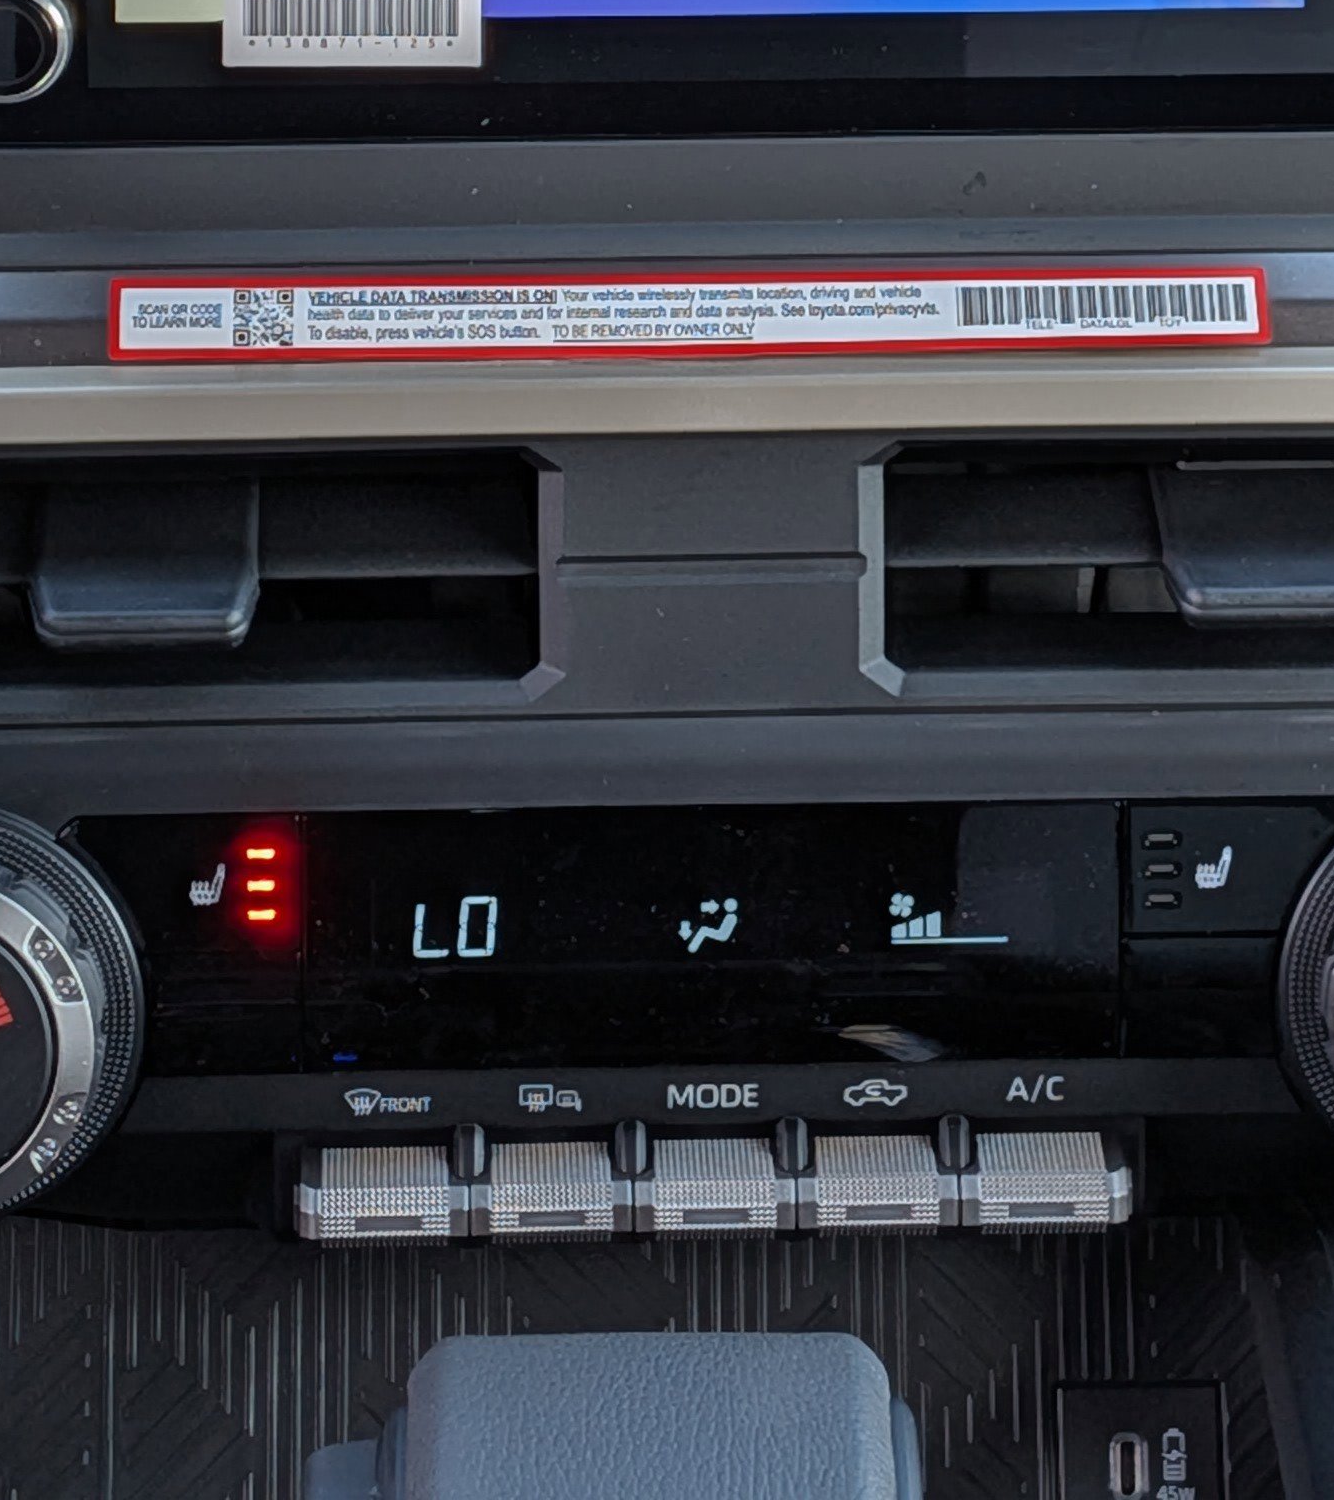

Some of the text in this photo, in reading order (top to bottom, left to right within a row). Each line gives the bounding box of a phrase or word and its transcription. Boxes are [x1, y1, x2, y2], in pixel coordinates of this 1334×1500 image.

[308, 289, 367, 306] VEHICLE
[370, 289, 407, 306] DATA
[410, 288, 514, 306] TRANSMISSION
[517, 289, 530, 305] IS
[561, 287, 589, 302] Your
[592, 288, 635, 301] vehicle
[636, 287, 697, 305] wirelessly
[698, 288, 754, 301] transmits
[756, 286, 808, 301] location,
[809, 285, 850, 303] driving
[854, 285, 876, 299] and
[879, 284, 922, 299] vehicle
[138, 303, 222, 315] SCAN QR CODE
[307, 308, 345, 321] health
[347, 308, 375, 321] data
[378, 308, 391, 321] to
[394, 308, 435, 321] deliver
[437, 309, 465, 324] your
[467, 309, 518, 321] services
[520, 306, 544, 320] and
[546, 306, 564, 320] for
[613, 305, 668, 319] research
[670, 304, 693, 318] and
[695, 304, 723, 318] data
[726, 303, 779, 321] analysis.
[781, 302, 806, 317] See
[132, 316, 222, 328] TO LEARN MORE
[307, 321, 756, 343] To disable, press vehicle's SOS button. TO BE REMOVED BY OWNER ONLY
[412, 896, 498, 958] LO
[666, 1083, 760, 1109] MODE
[1005, 1075, 1065, 1103] A/C
[379, 1096, 432, 1113] FRONT
